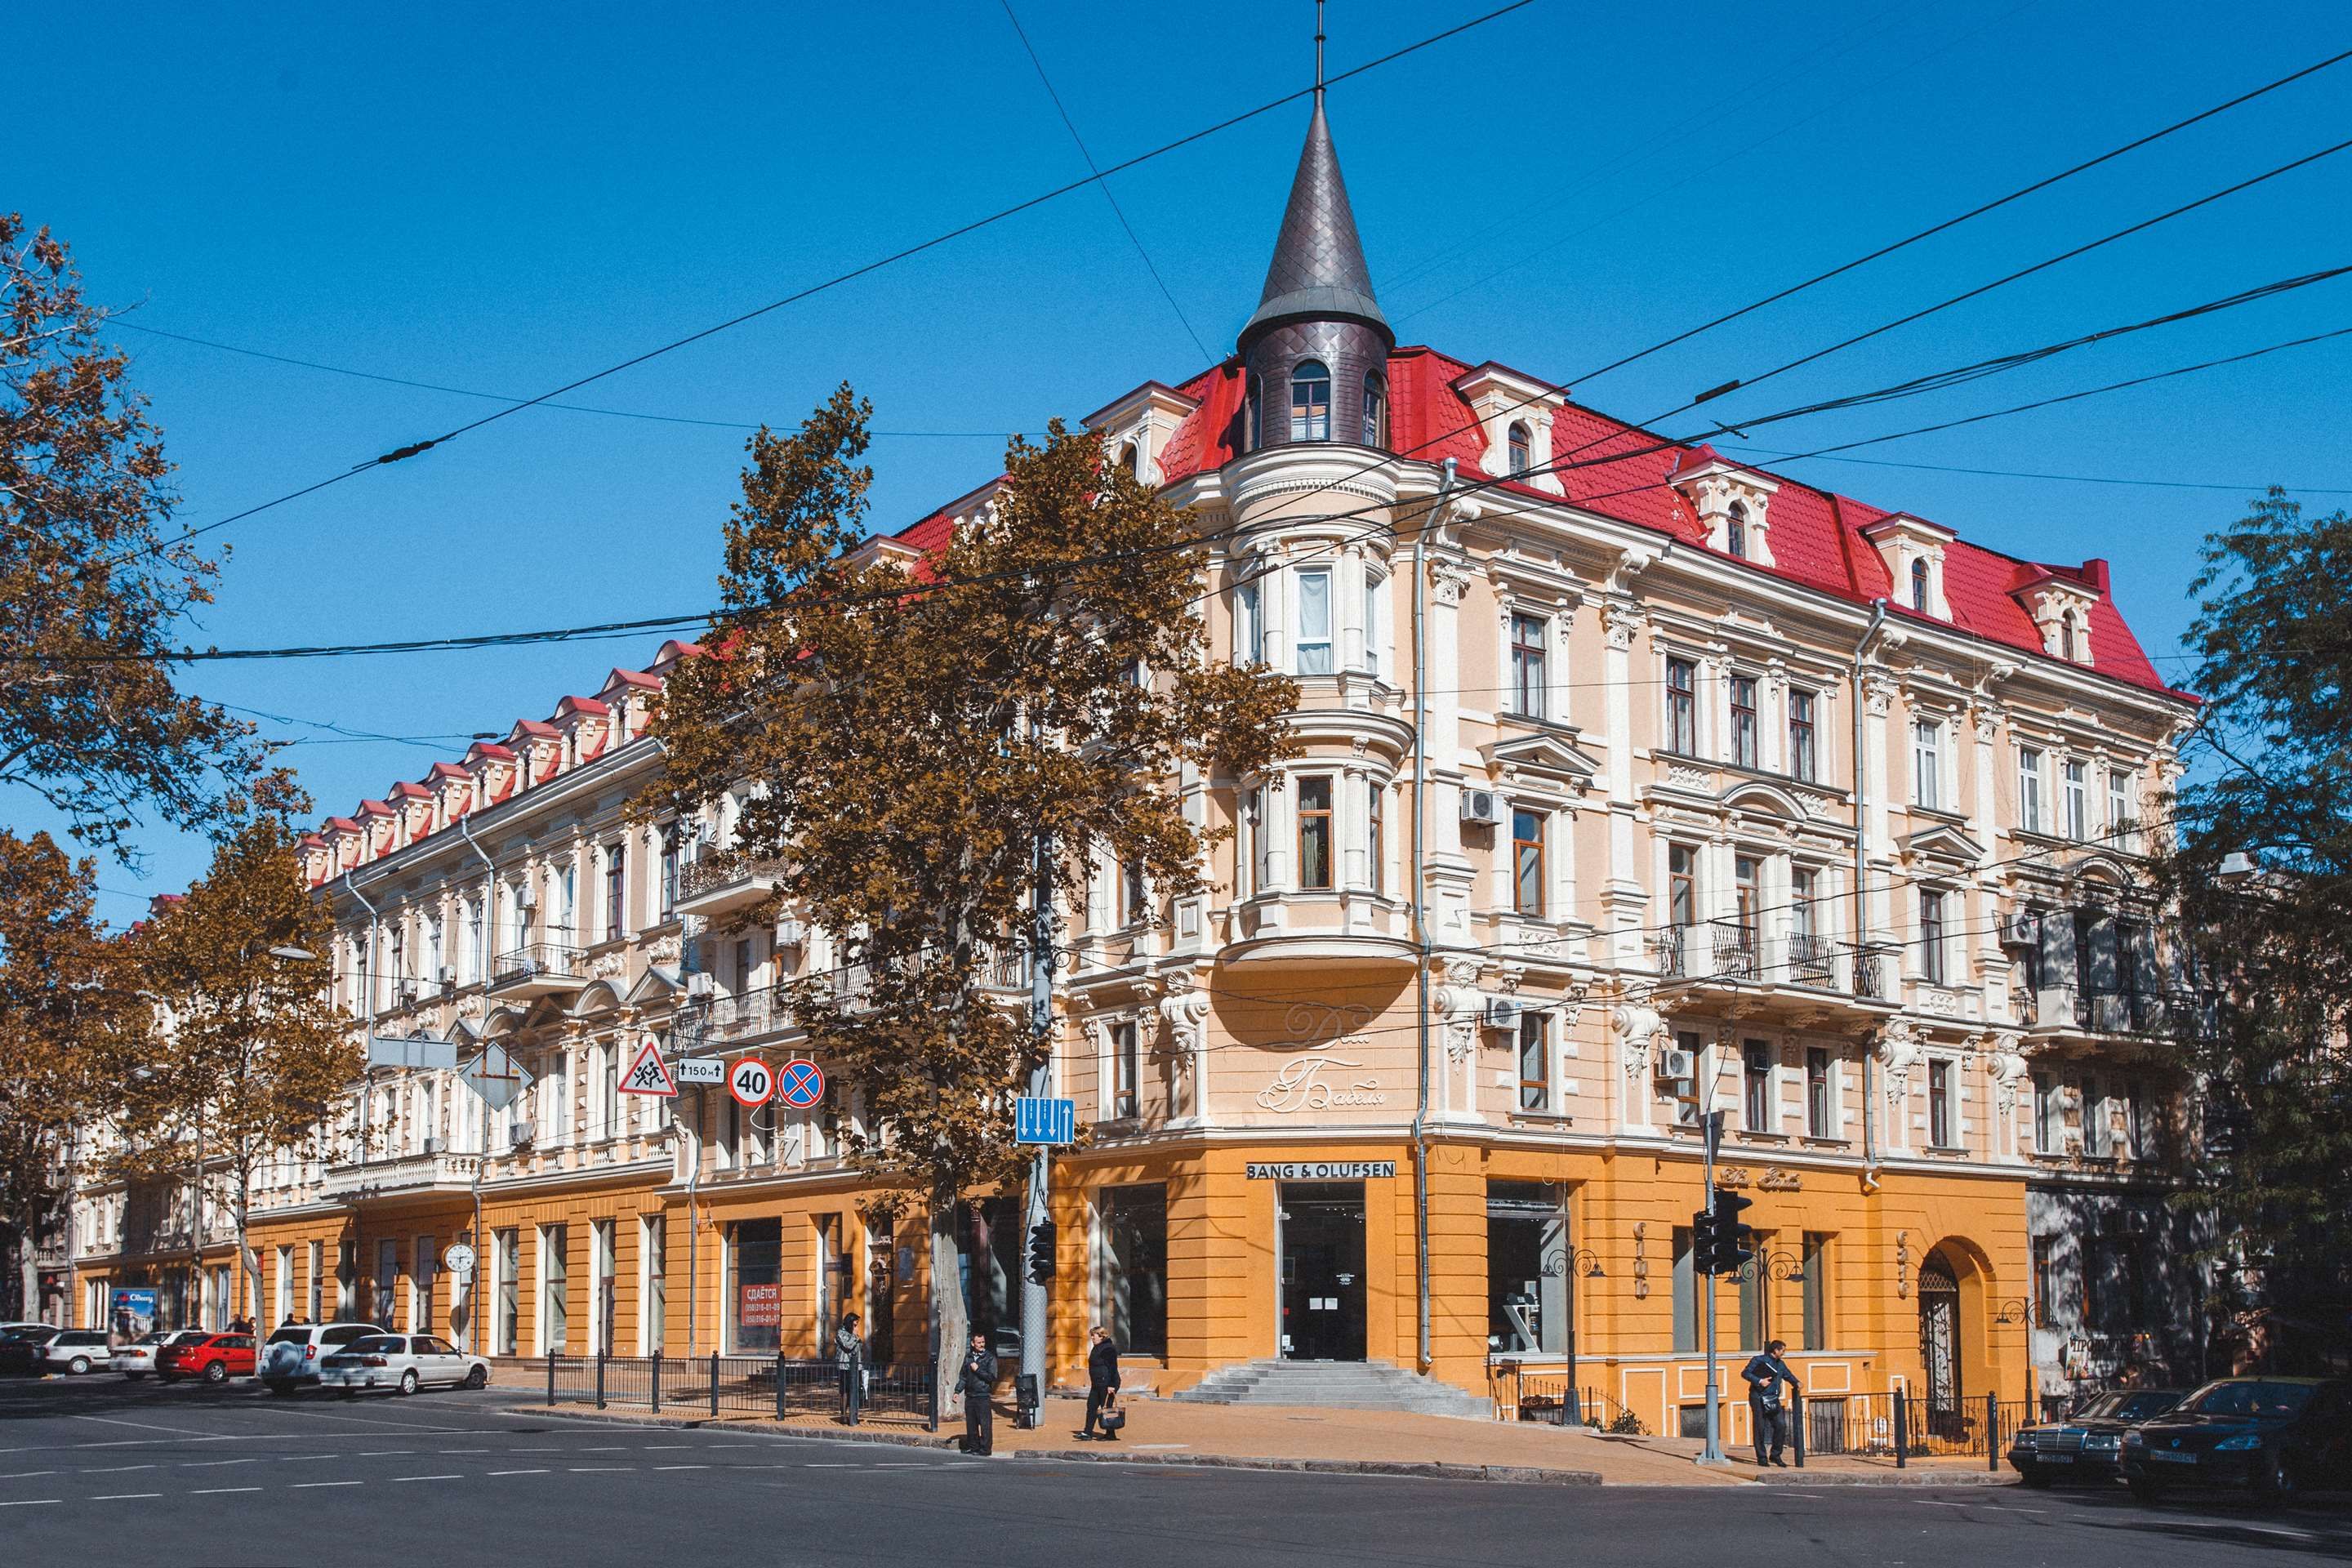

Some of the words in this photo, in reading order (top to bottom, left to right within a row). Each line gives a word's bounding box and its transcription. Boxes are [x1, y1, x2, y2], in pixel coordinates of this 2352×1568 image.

[737, 1070, 766, 1094] 40
[1255, 1055, 1386, 1114] Бабеля
[1247, 1165, 1294, 1179] BANG
[1301, 1165, 1311, 1178] &
[1316, 1163, 1394, 1177] OLUFSEN
[746, 1285, 777, 1301] СДАЁТСЯ
